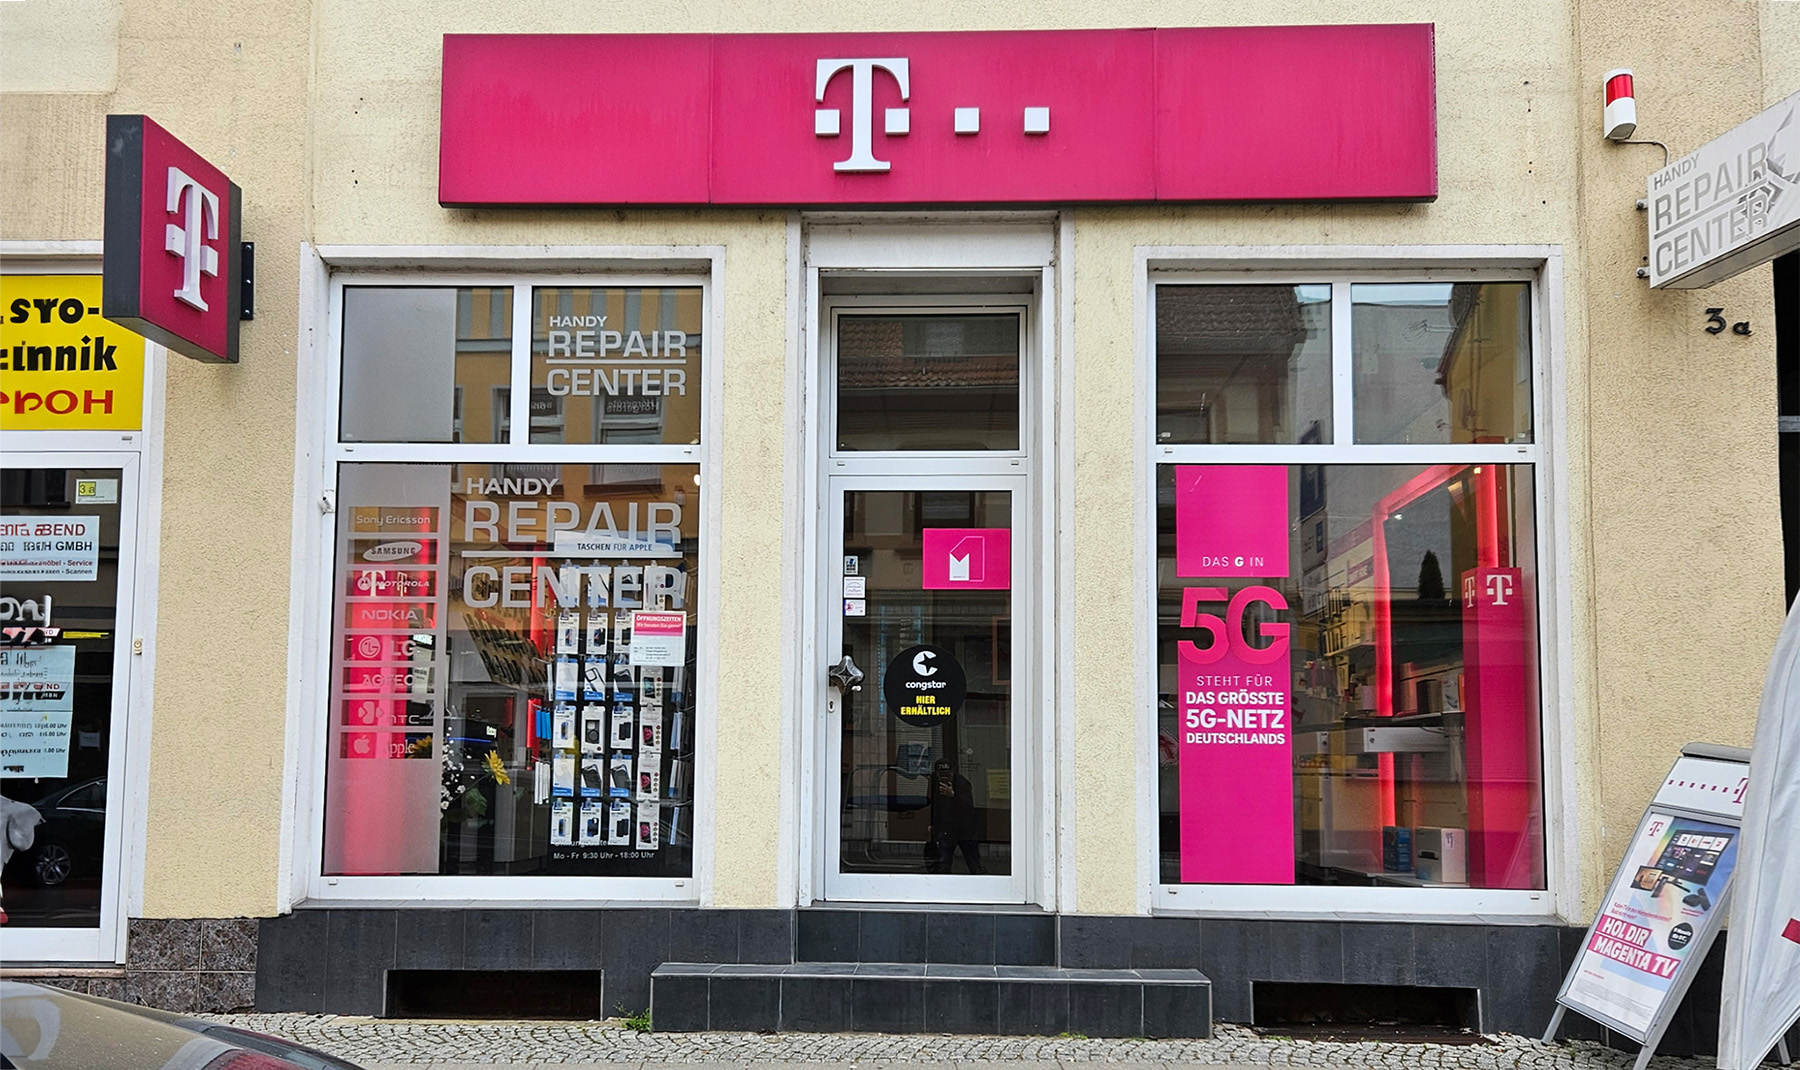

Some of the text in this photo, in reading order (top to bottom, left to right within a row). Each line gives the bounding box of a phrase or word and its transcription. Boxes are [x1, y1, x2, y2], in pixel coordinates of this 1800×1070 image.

[1654, 154, 1700, 191] HANDY
[1655, 141, 1768, 232] REPAIR
[1655, 192, 1769, 278] CENTER
[550, 316, 607, 327] HANDY
[1705, 307, 1726, 335] 3
[549, 330, 687, 358] REPAIR
[547, 369, 687, 396] CENTER
[466, 478, 559, 496] HANDY
[356, 515, 431, 526] Sony Ericsson
[464, 500, 683, 545] REPAIR
[55, 541, 93, 551] GMBH
[371, 546, 416, 555] SAMSUNG
[577, 542, 653, 552] TASCHEN FÜR APPLE
[1202, 556, 1264, 567] DAS G IN
[376, 580, 430, 588] MOTOROLA
[463, 565, 685, 608] CENTER
[361, 610, 418, 620] NOKIA
[1177, 585, 1291, 665] 5G
[391, 640, 416, 656] LG
[905, 680, 947, 691] congstar
[1196, 674, 1273, 687] STEHT FÜR
[916, 695, 936, 704] HIER
[1186, 688, 1284, 705] DAS GRÖSSTE
[900, 705, 951, 715] ERHÄLTLICH
[1186, 708, 1284, 729] 5G-NETZ
[1186, 732, 1286, 745] DEUTSCHLANDS
[1602, 917, 1627, 940] HOL
[1626, 925, 1649, 948] DIR
[1593, 935, 1679, 977] MAGENTA TV
